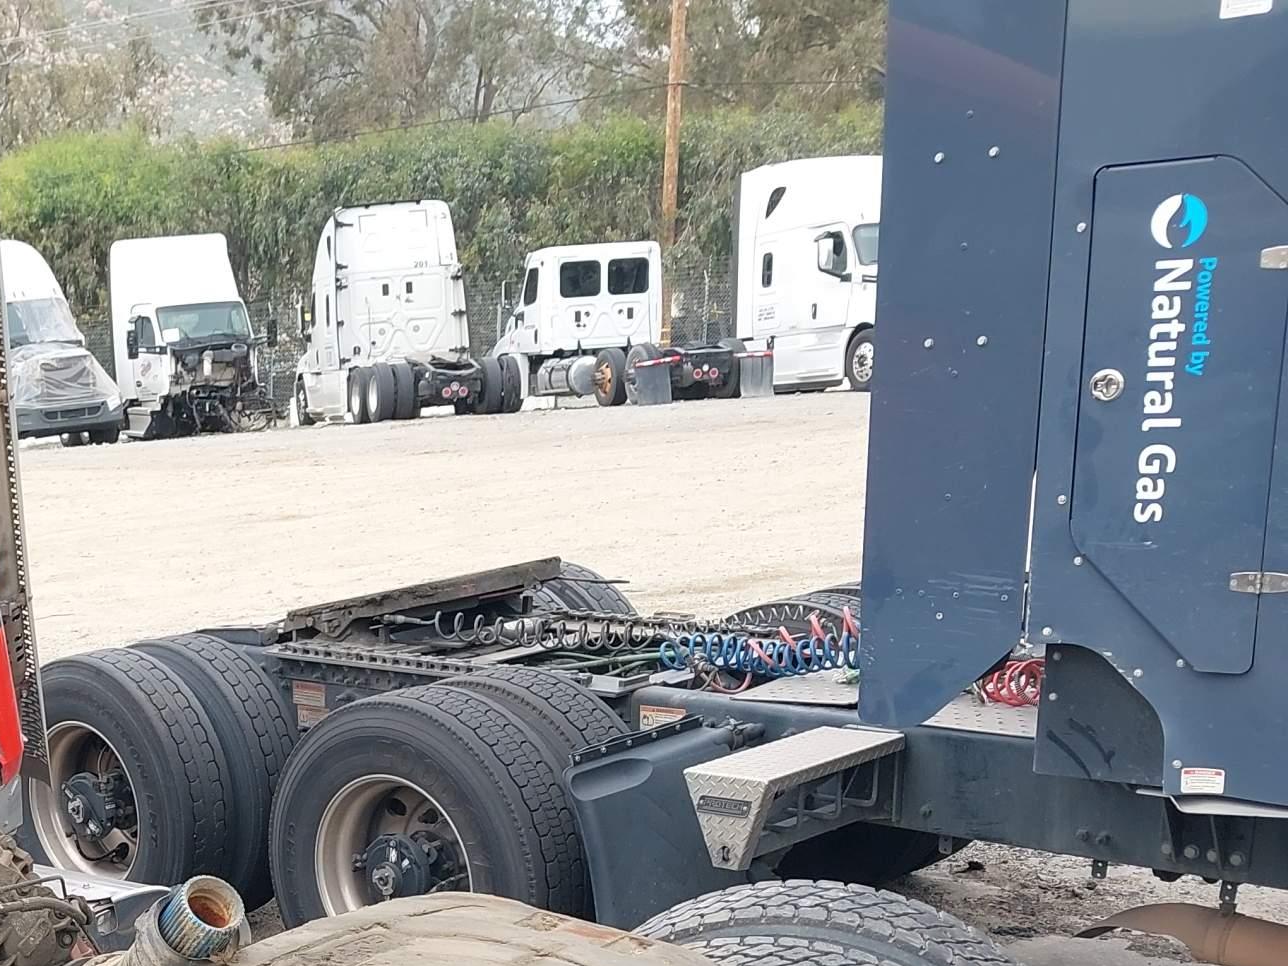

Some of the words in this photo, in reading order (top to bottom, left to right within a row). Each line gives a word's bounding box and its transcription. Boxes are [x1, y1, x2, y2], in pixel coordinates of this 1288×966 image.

[1191, 257, 1218, 345] Powered
[1141, 258, 1194, 432] Natural
[1185, 351, 1210, 376] by
[1133, 443, 1177, 523] Gas
